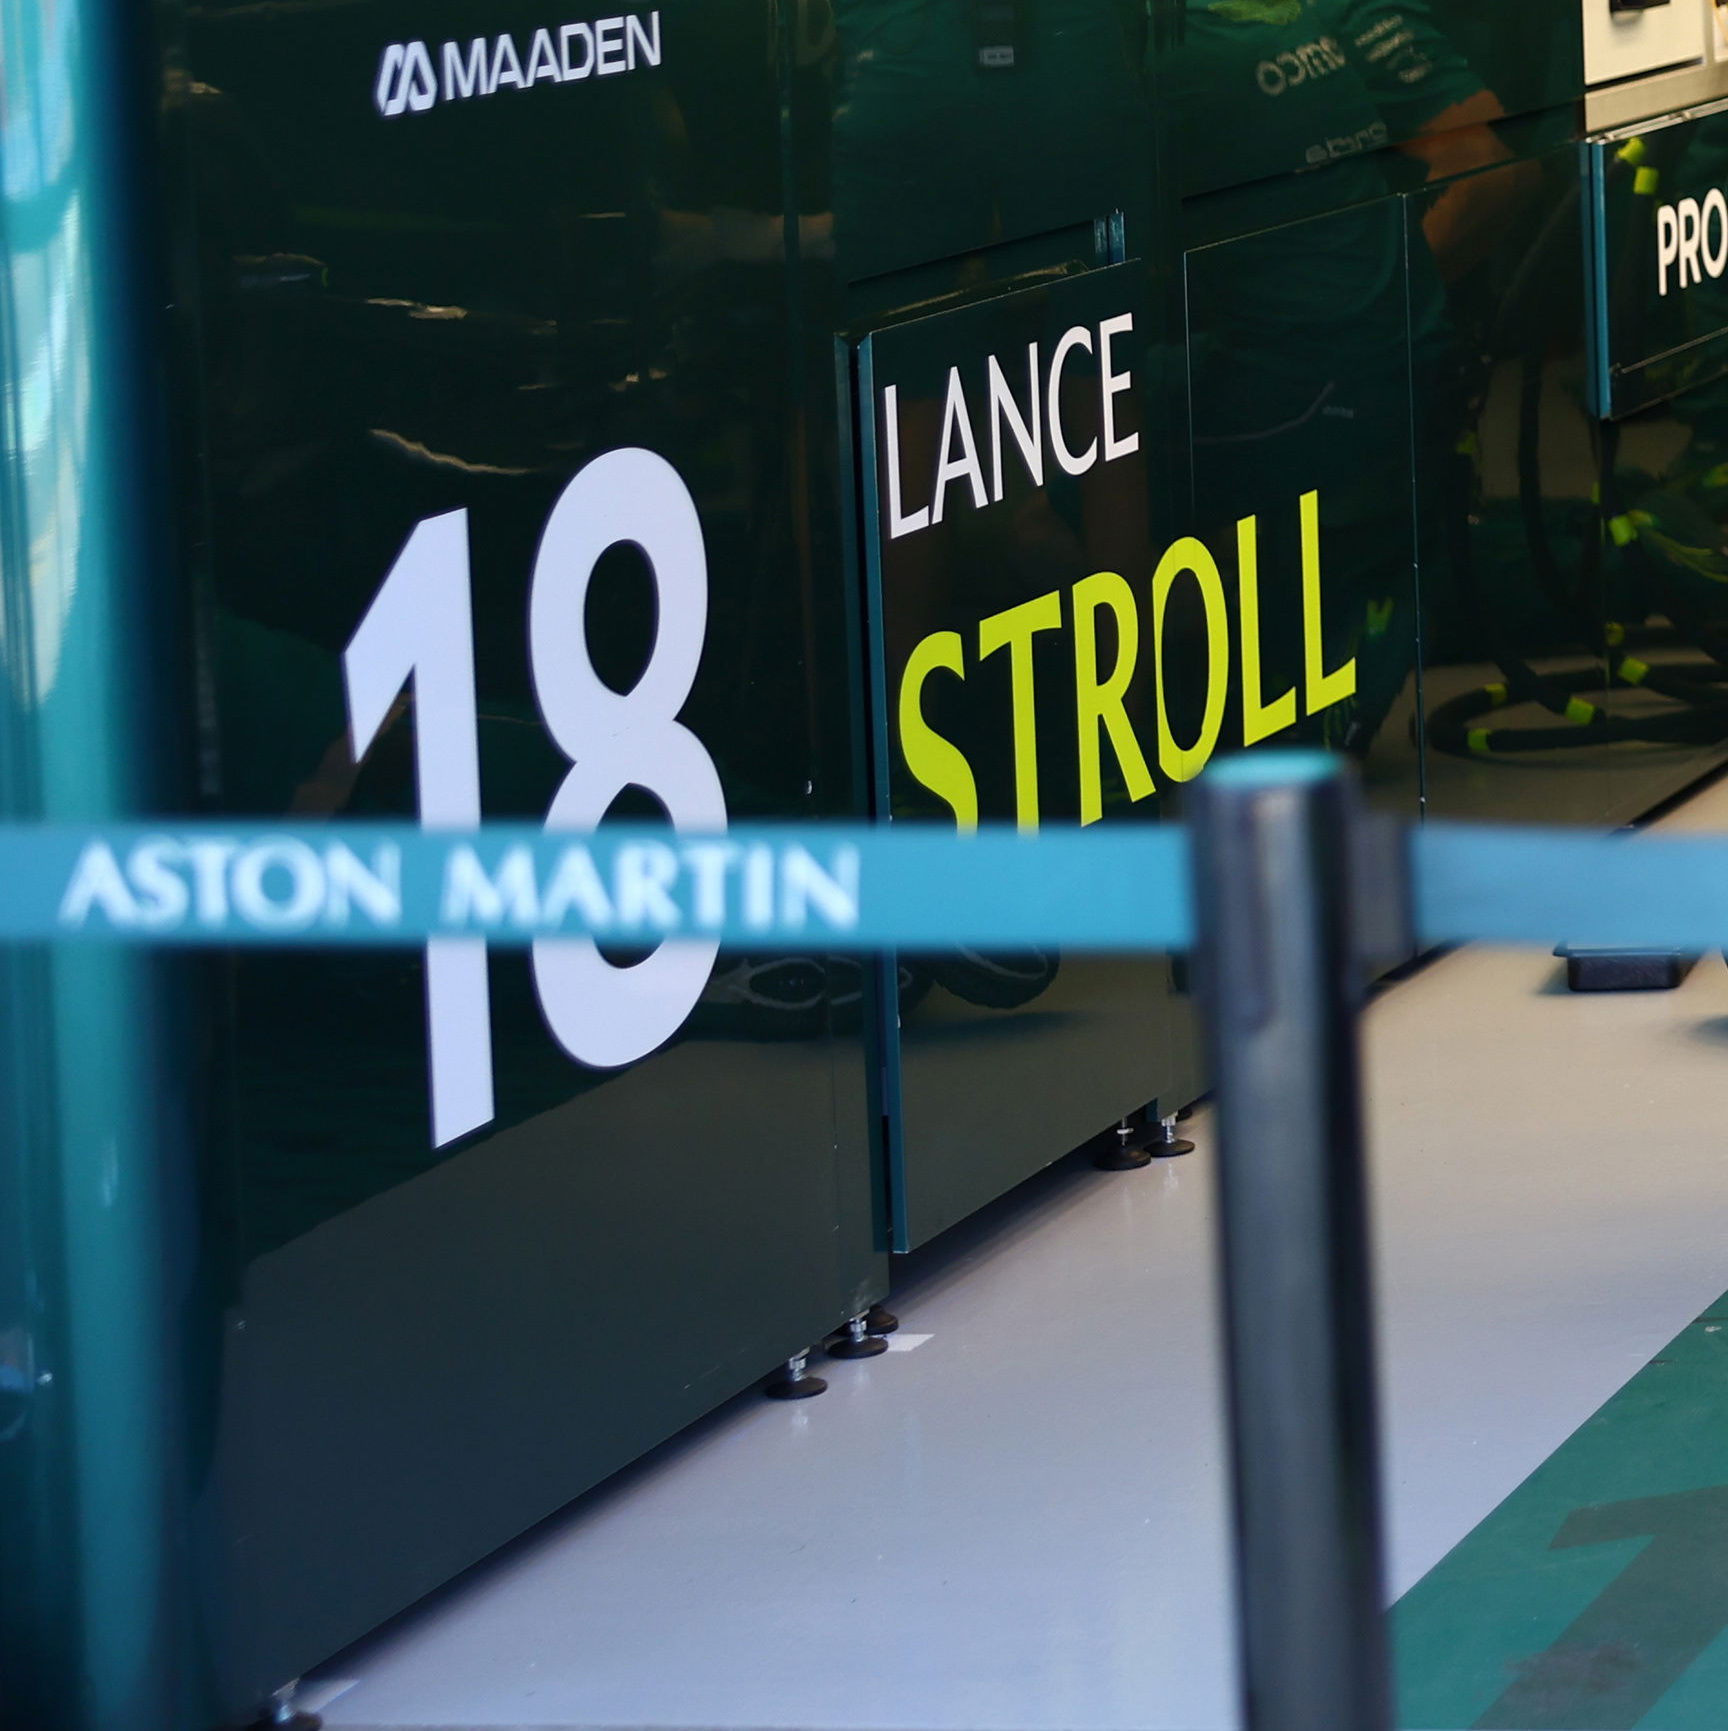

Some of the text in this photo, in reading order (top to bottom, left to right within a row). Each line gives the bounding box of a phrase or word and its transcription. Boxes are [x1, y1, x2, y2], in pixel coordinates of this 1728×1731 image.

[442, 11, 663, 102] MAADEN
[884, 311, 1140, 540] LANCE
[899, 488, 1357, 838] STROLL
[59, 833, 862, 931] ASTON MARTIN
[343, 446, 729, 1149] 18
